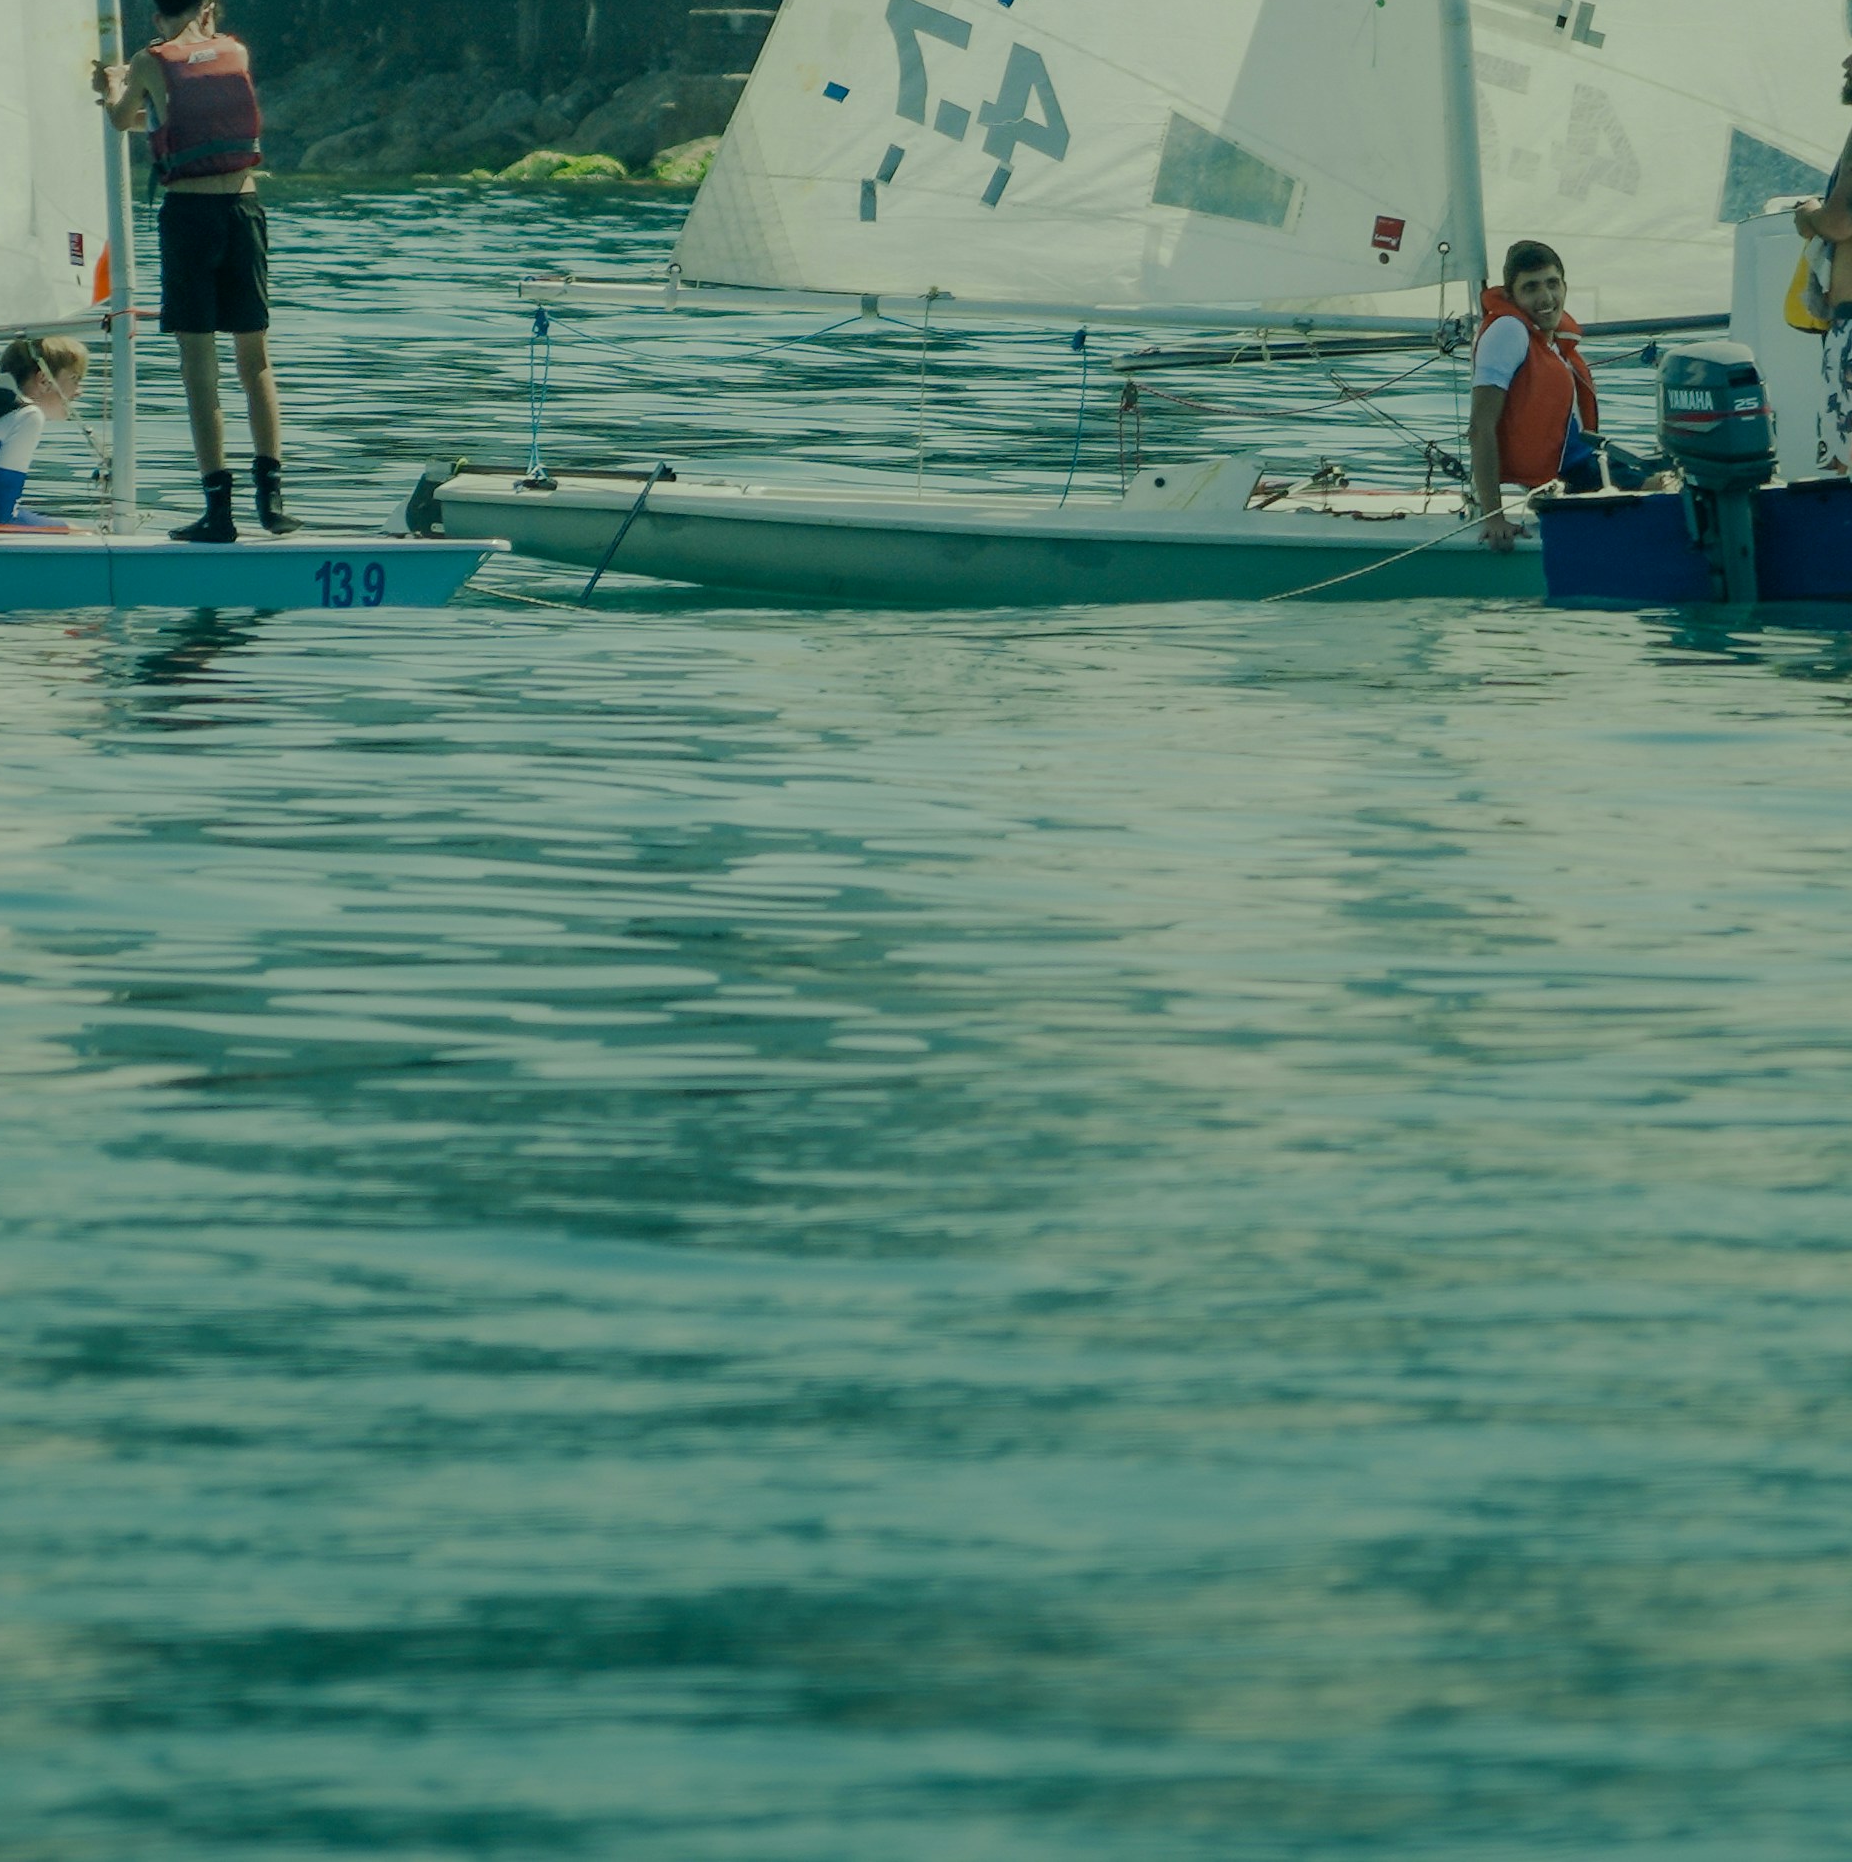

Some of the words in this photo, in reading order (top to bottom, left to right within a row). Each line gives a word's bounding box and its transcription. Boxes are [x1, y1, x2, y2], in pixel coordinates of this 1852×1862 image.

[1667, 389, 1714, 411] YAMAHA
[1733, 396, 1760, 411] 25
[314, 560, 386, 608] 139
